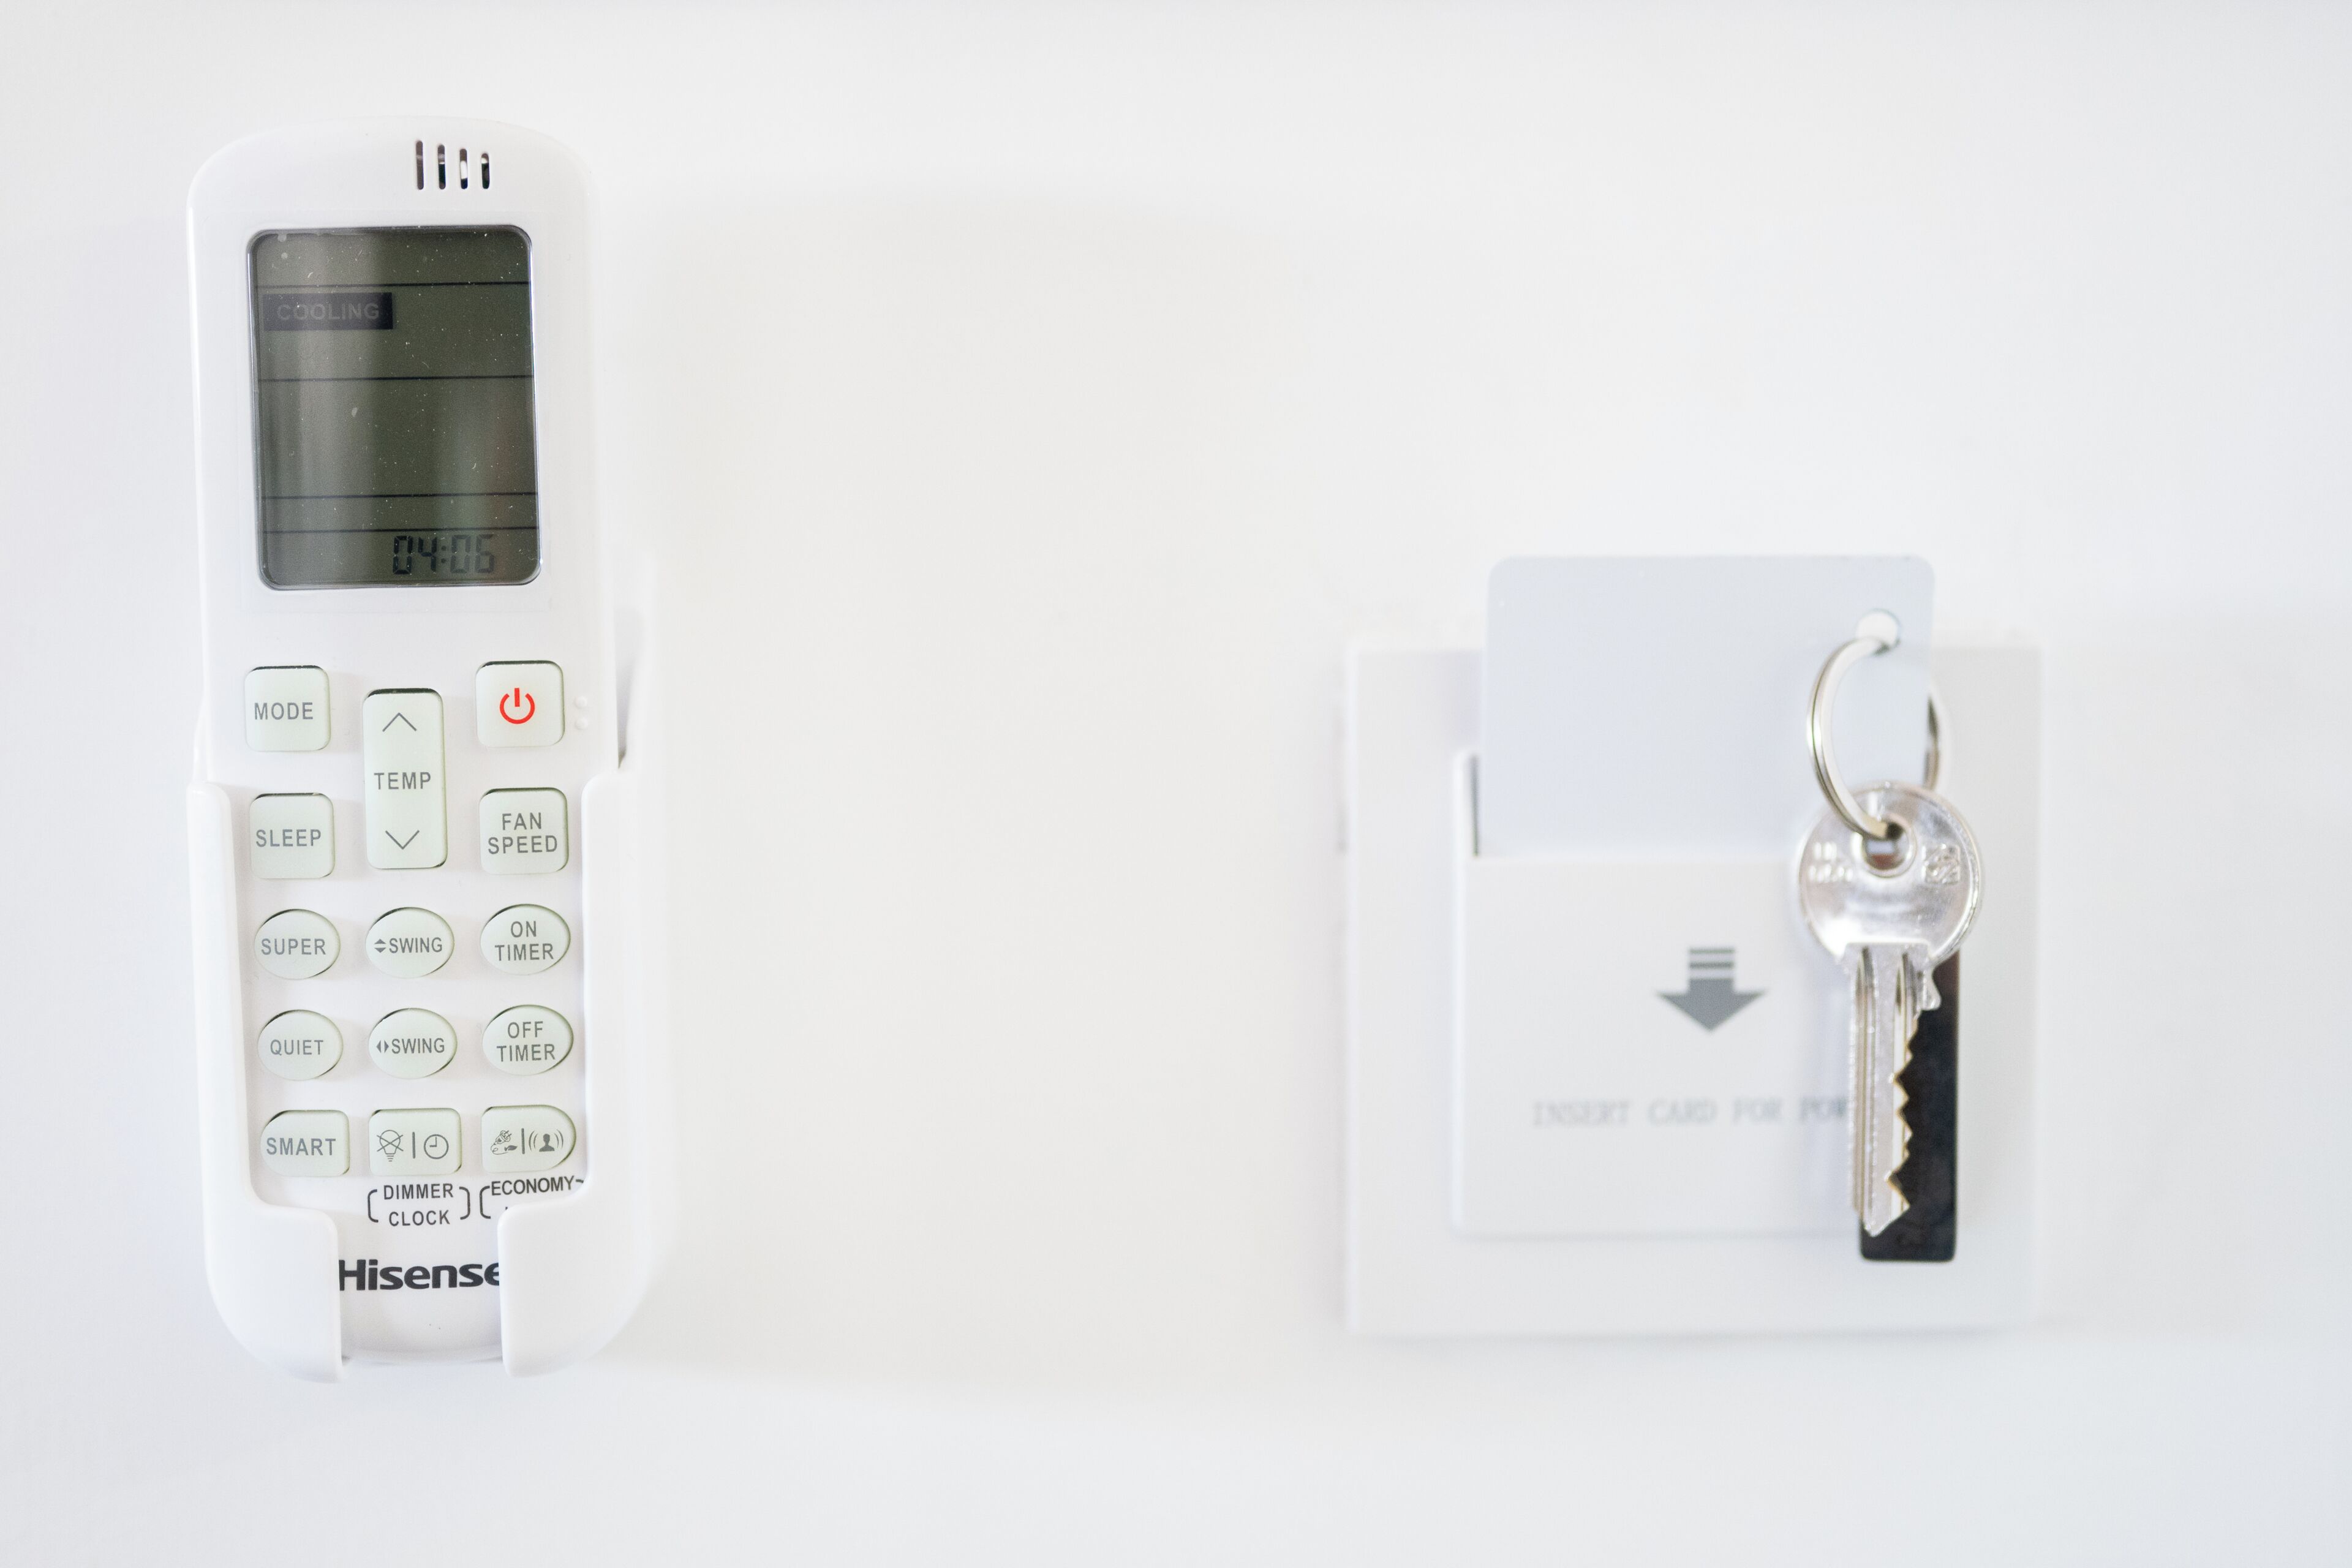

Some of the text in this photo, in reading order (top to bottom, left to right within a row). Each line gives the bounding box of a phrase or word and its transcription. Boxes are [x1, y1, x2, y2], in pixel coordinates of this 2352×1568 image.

[277, 303, 380, 322] COOLING
[392, 534, 495, 575] 04:06
[254, 702, 314, 720] MODE
[374, 771, 431, 790] TEMP
[502, 812, 542, 831] FAN
[255, 829, 322, 848] SLEEP
[488, 835, 558, 855] SPEED
[510, 921, 537, 938] ON
[261, 938, 326, 956] SUPER
[389, 937, 443, 954] SWING
[494, 943, 554, 961] TIMER
[507, 1020, 544, 1039] OFF
[270, 1039, 324, 1056] QUIET
[391, 1038, 445, 1054] SWING
[496, 1043, 556, 1062] TIMER
[1533, 1095, 1849, 1127] INSERT CARD FOR POW
[266, 1137, 336, 1156] SMART
[383, 1183, 454, 1200] DIMMER
[491, 1175, 575, 1196] ECONOMY
[388, 1210, 450, 1227] CLOCK
